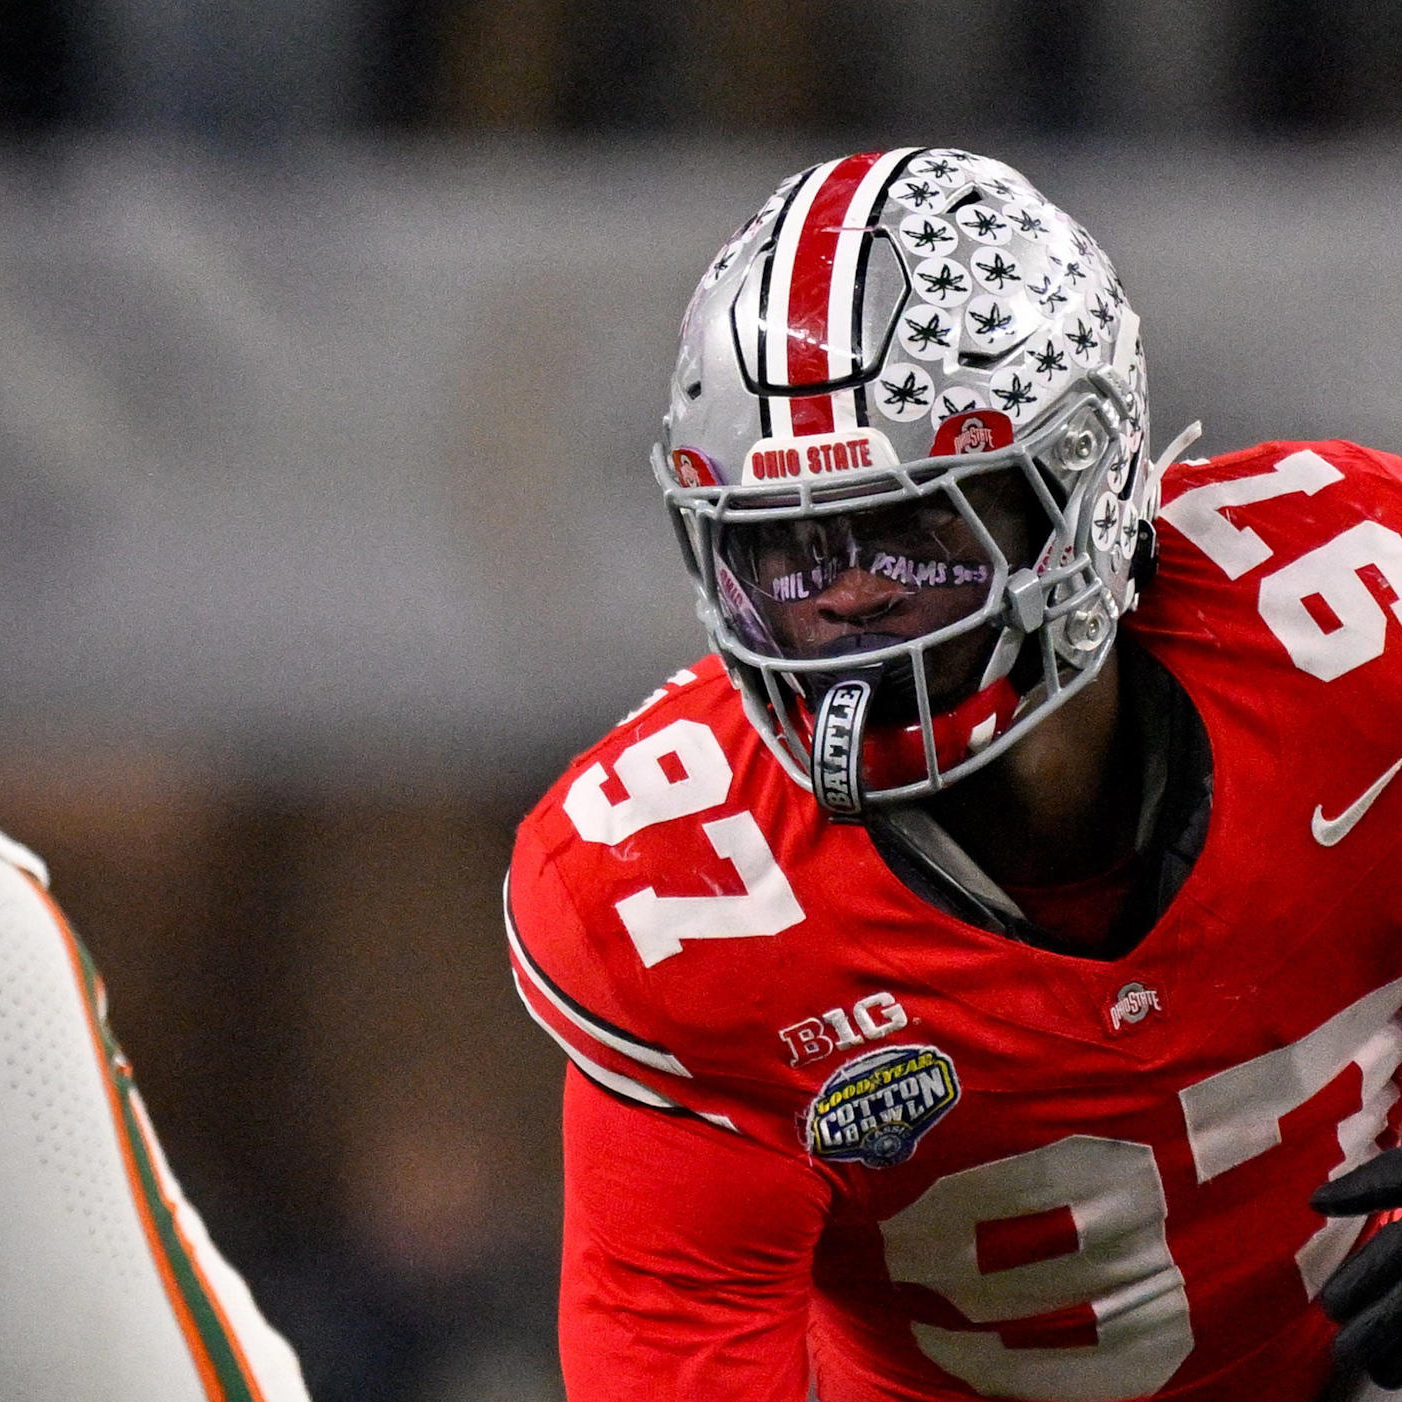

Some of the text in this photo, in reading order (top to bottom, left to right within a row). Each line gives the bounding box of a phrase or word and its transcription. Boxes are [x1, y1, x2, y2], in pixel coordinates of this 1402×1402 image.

[751, 438, 873, 480] OHIO STATE
[772, 571, 810, 601] PHIL
[869, 552, 948, 587] PSALMS
[822, 687, 862, 806] BATTLE
[563, 718, 807, 969] 97
[1127, 990, 1162, 1013] STATE
[818, 1052, 935, 1115] GOODYEAR
[819, 1066, 946, 1147] COTTON
[842, 1099, 925, 1145] BOWL
